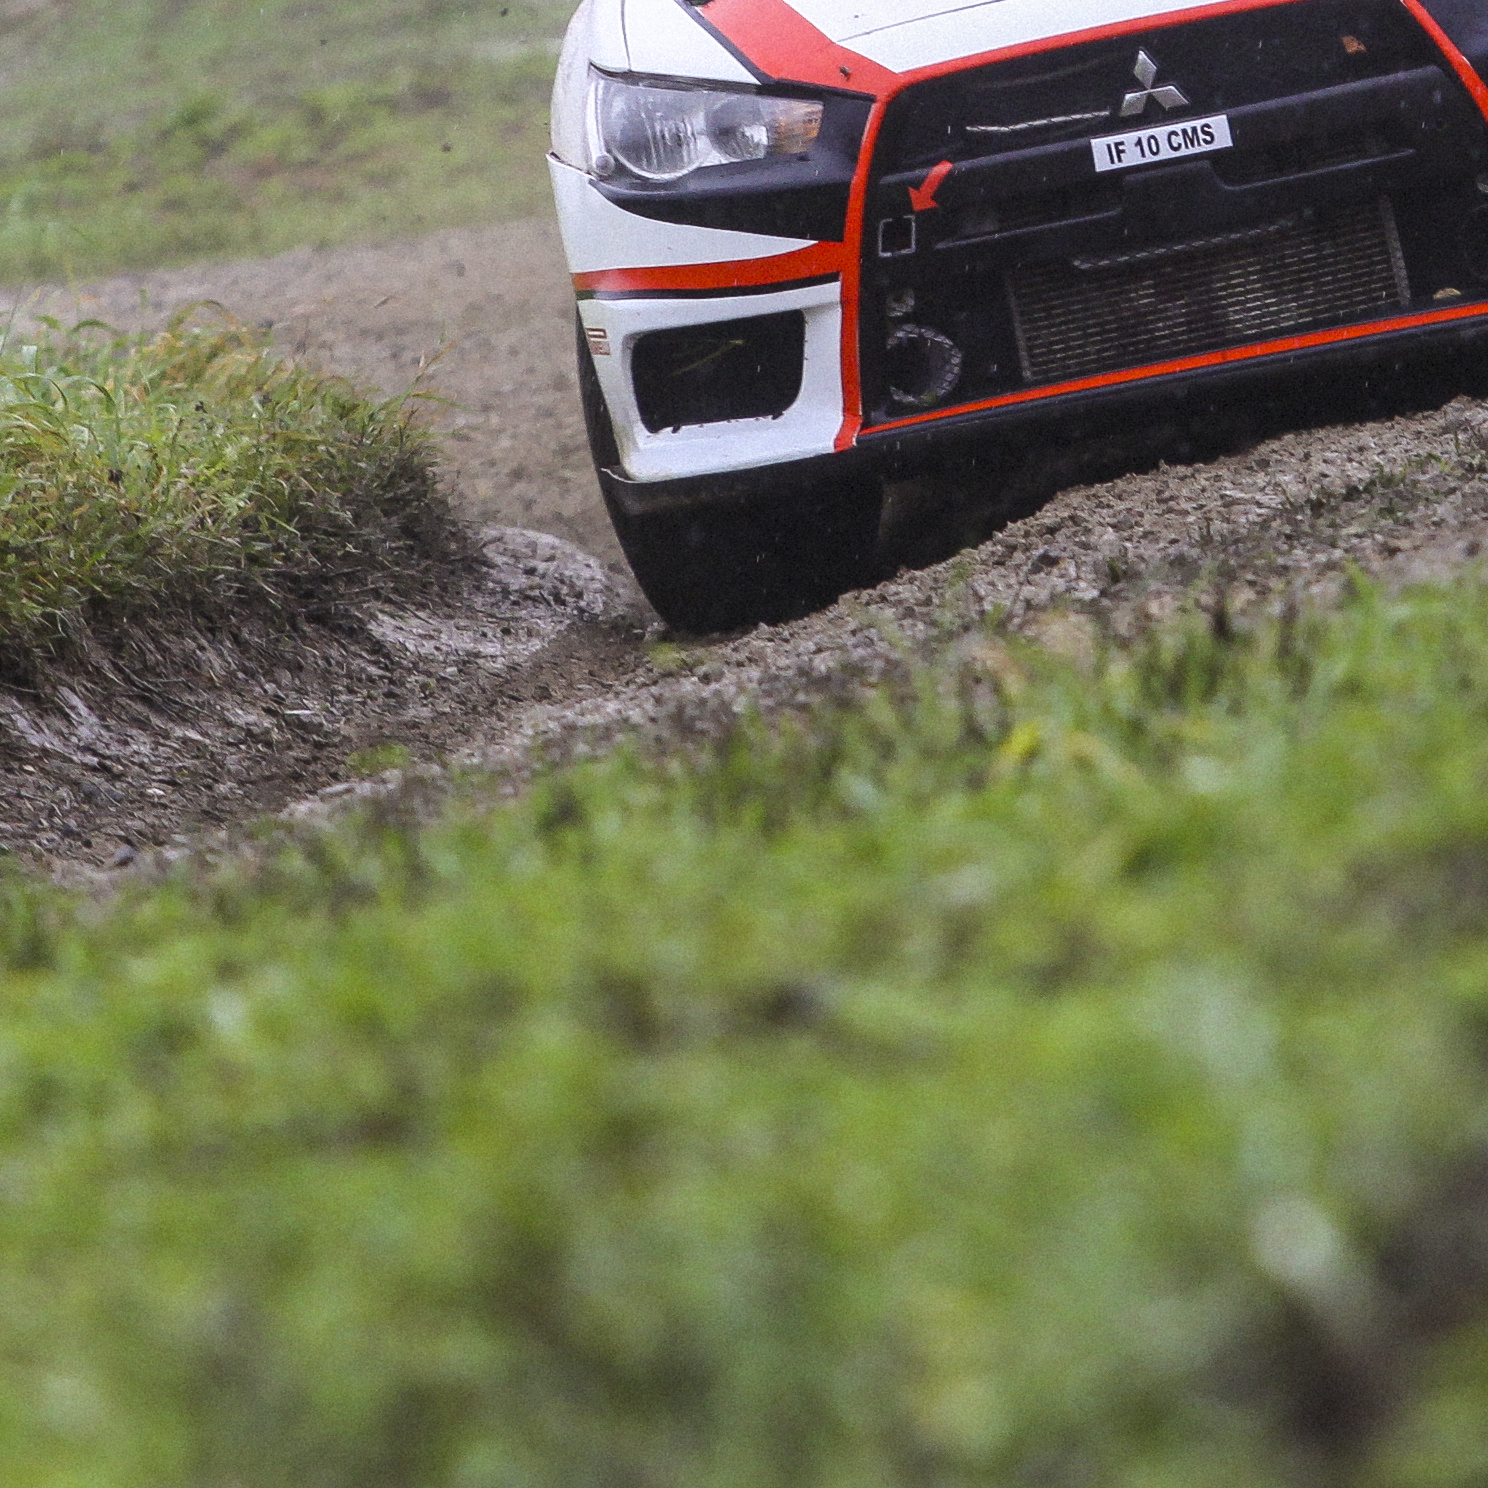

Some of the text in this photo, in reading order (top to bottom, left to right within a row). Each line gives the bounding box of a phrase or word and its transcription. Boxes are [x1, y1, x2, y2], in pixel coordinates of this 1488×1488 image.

[1106, 122, 1216, 165] IF 10 CMS
